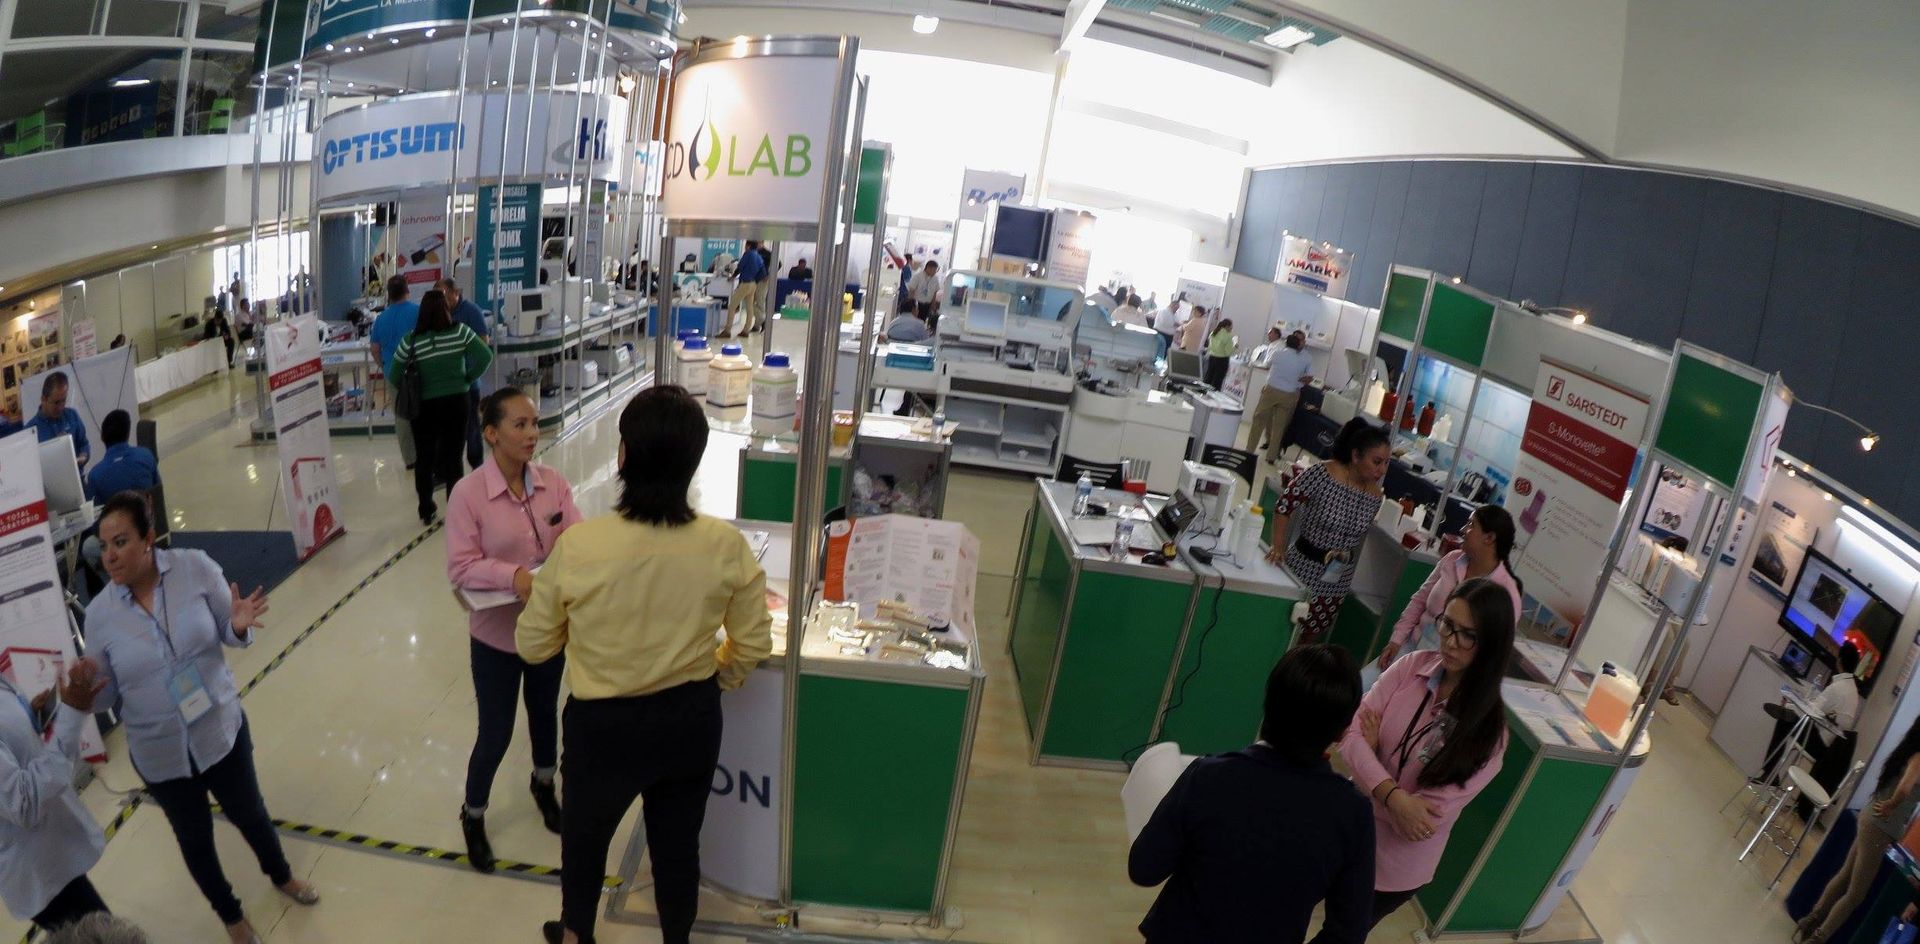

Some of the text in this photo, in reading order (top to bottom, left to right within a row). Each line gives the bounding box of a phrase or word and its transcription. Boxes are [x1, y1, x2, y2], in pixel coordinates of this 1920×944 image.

[323, 123, 464, 175] OPTISUM
[728, 133, 812, 178] LAB
[1566, 393, 1628, 430] SARSTEDT
[0, 513, 40, 532] ORATORIO
